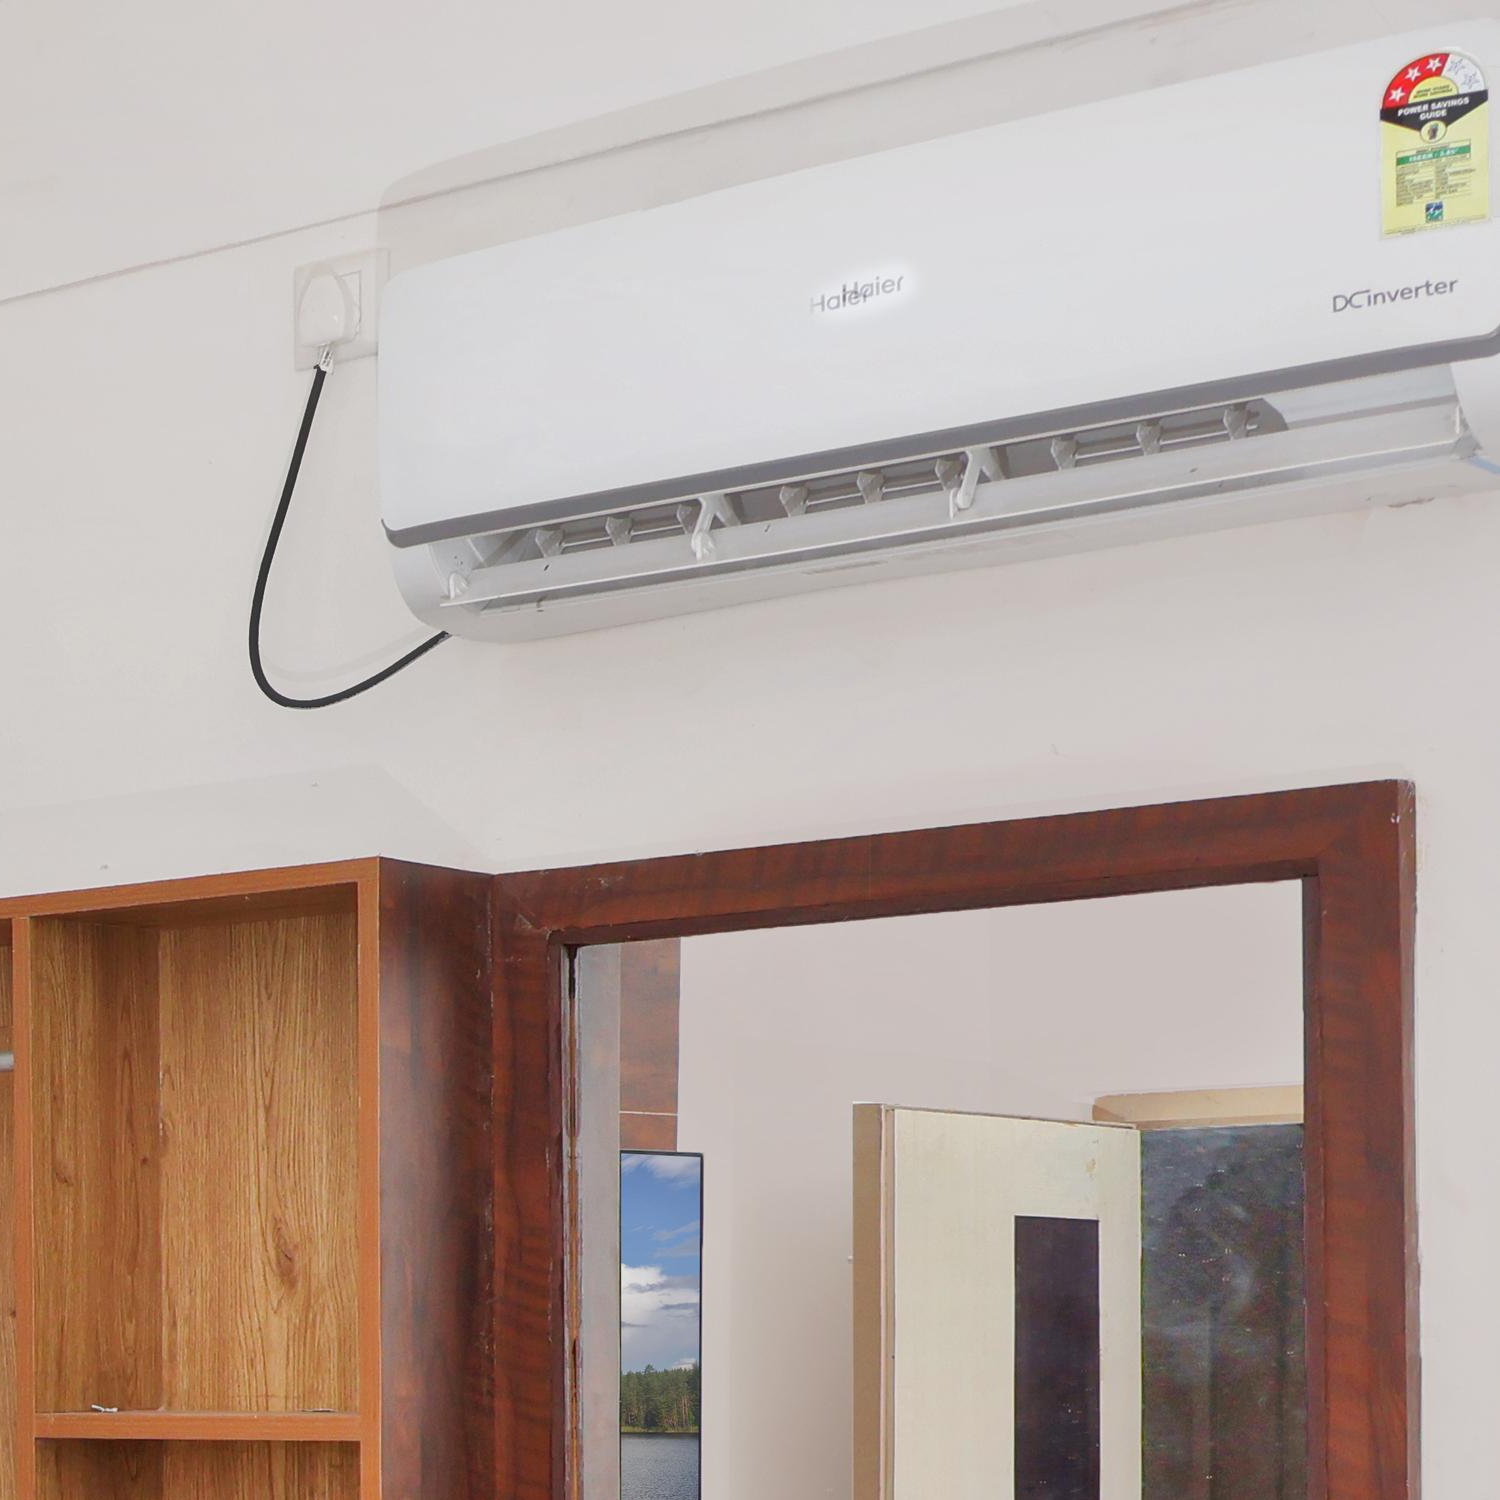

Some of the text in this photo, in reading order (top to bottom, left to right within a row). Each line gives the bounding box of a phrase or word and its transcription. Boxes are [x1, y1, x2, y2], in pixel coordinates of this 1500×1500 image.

[1398, 97, 1470, 116] POWER SAVINGS
[1420, 109, 1447, 120] GUIDE
